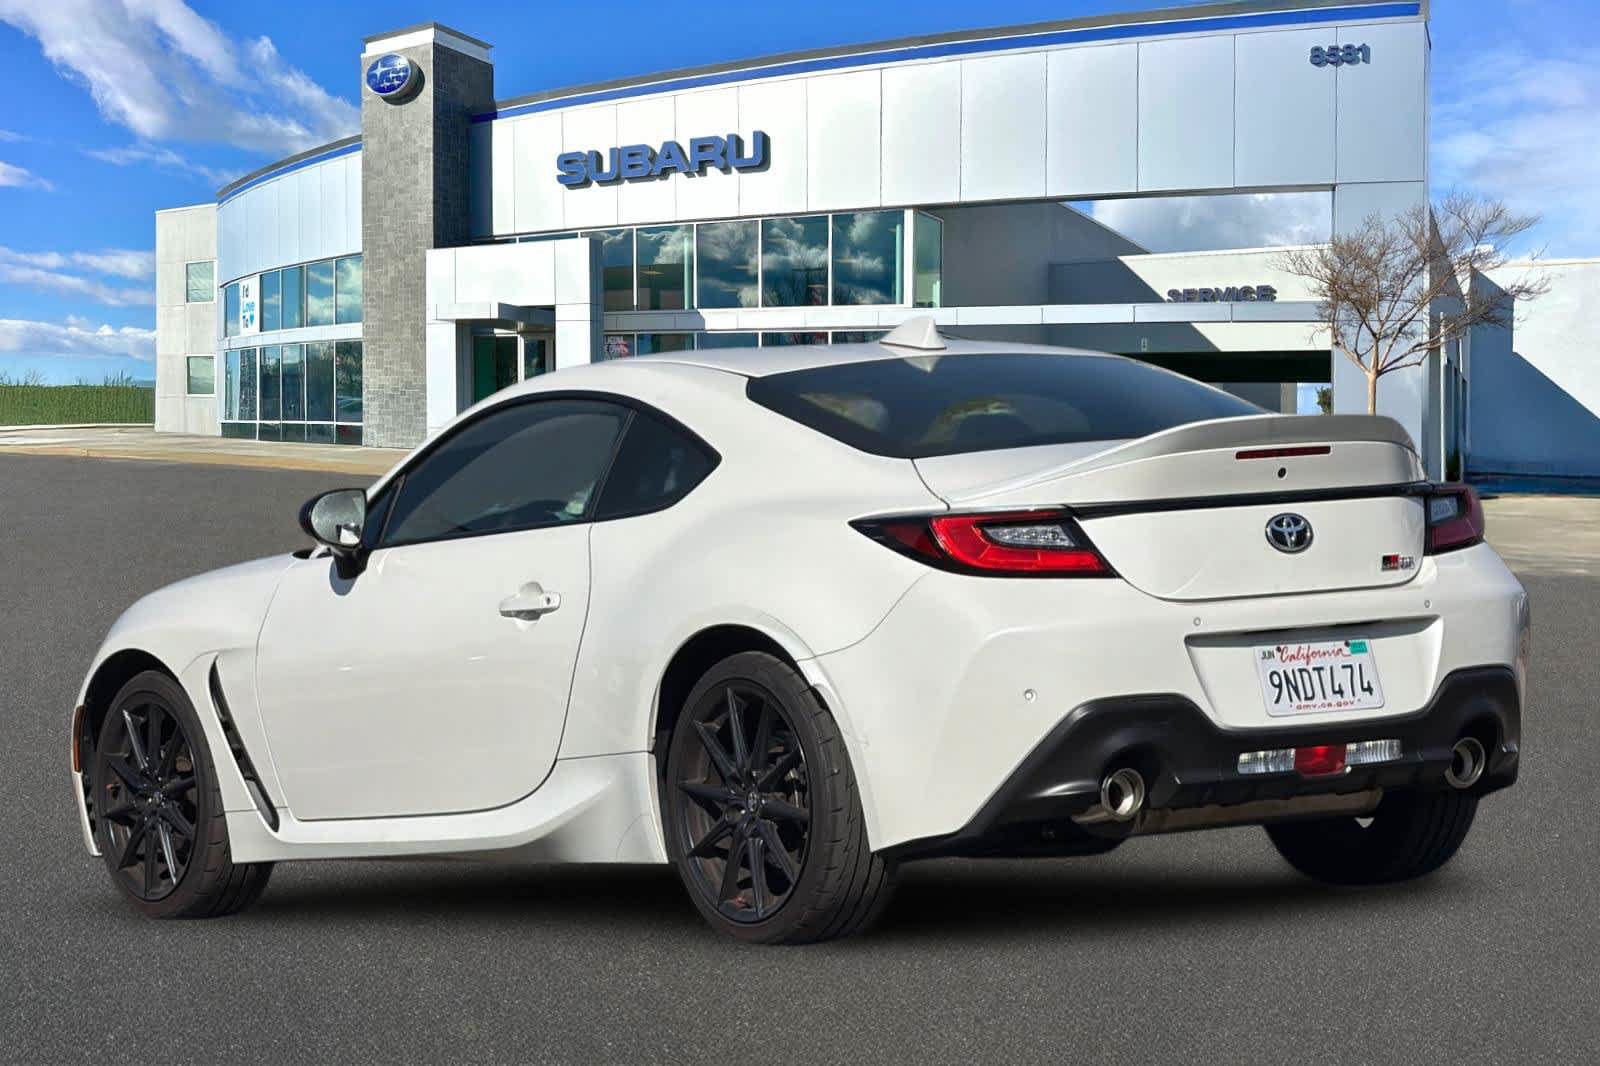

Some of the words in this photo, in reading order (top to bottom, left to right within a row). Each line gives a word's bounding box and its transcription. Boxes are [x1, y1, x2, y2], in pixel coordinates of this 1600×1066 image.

[556, 130, 771, 190] SUBARU
[1166, 285, 1278, 302] SERVICE
[1279, 646, 1351, 666] California
[1269, 663, 1374, 704] 9NDT474
[1295, 699, 1355, 711] dmv.ca.gov
